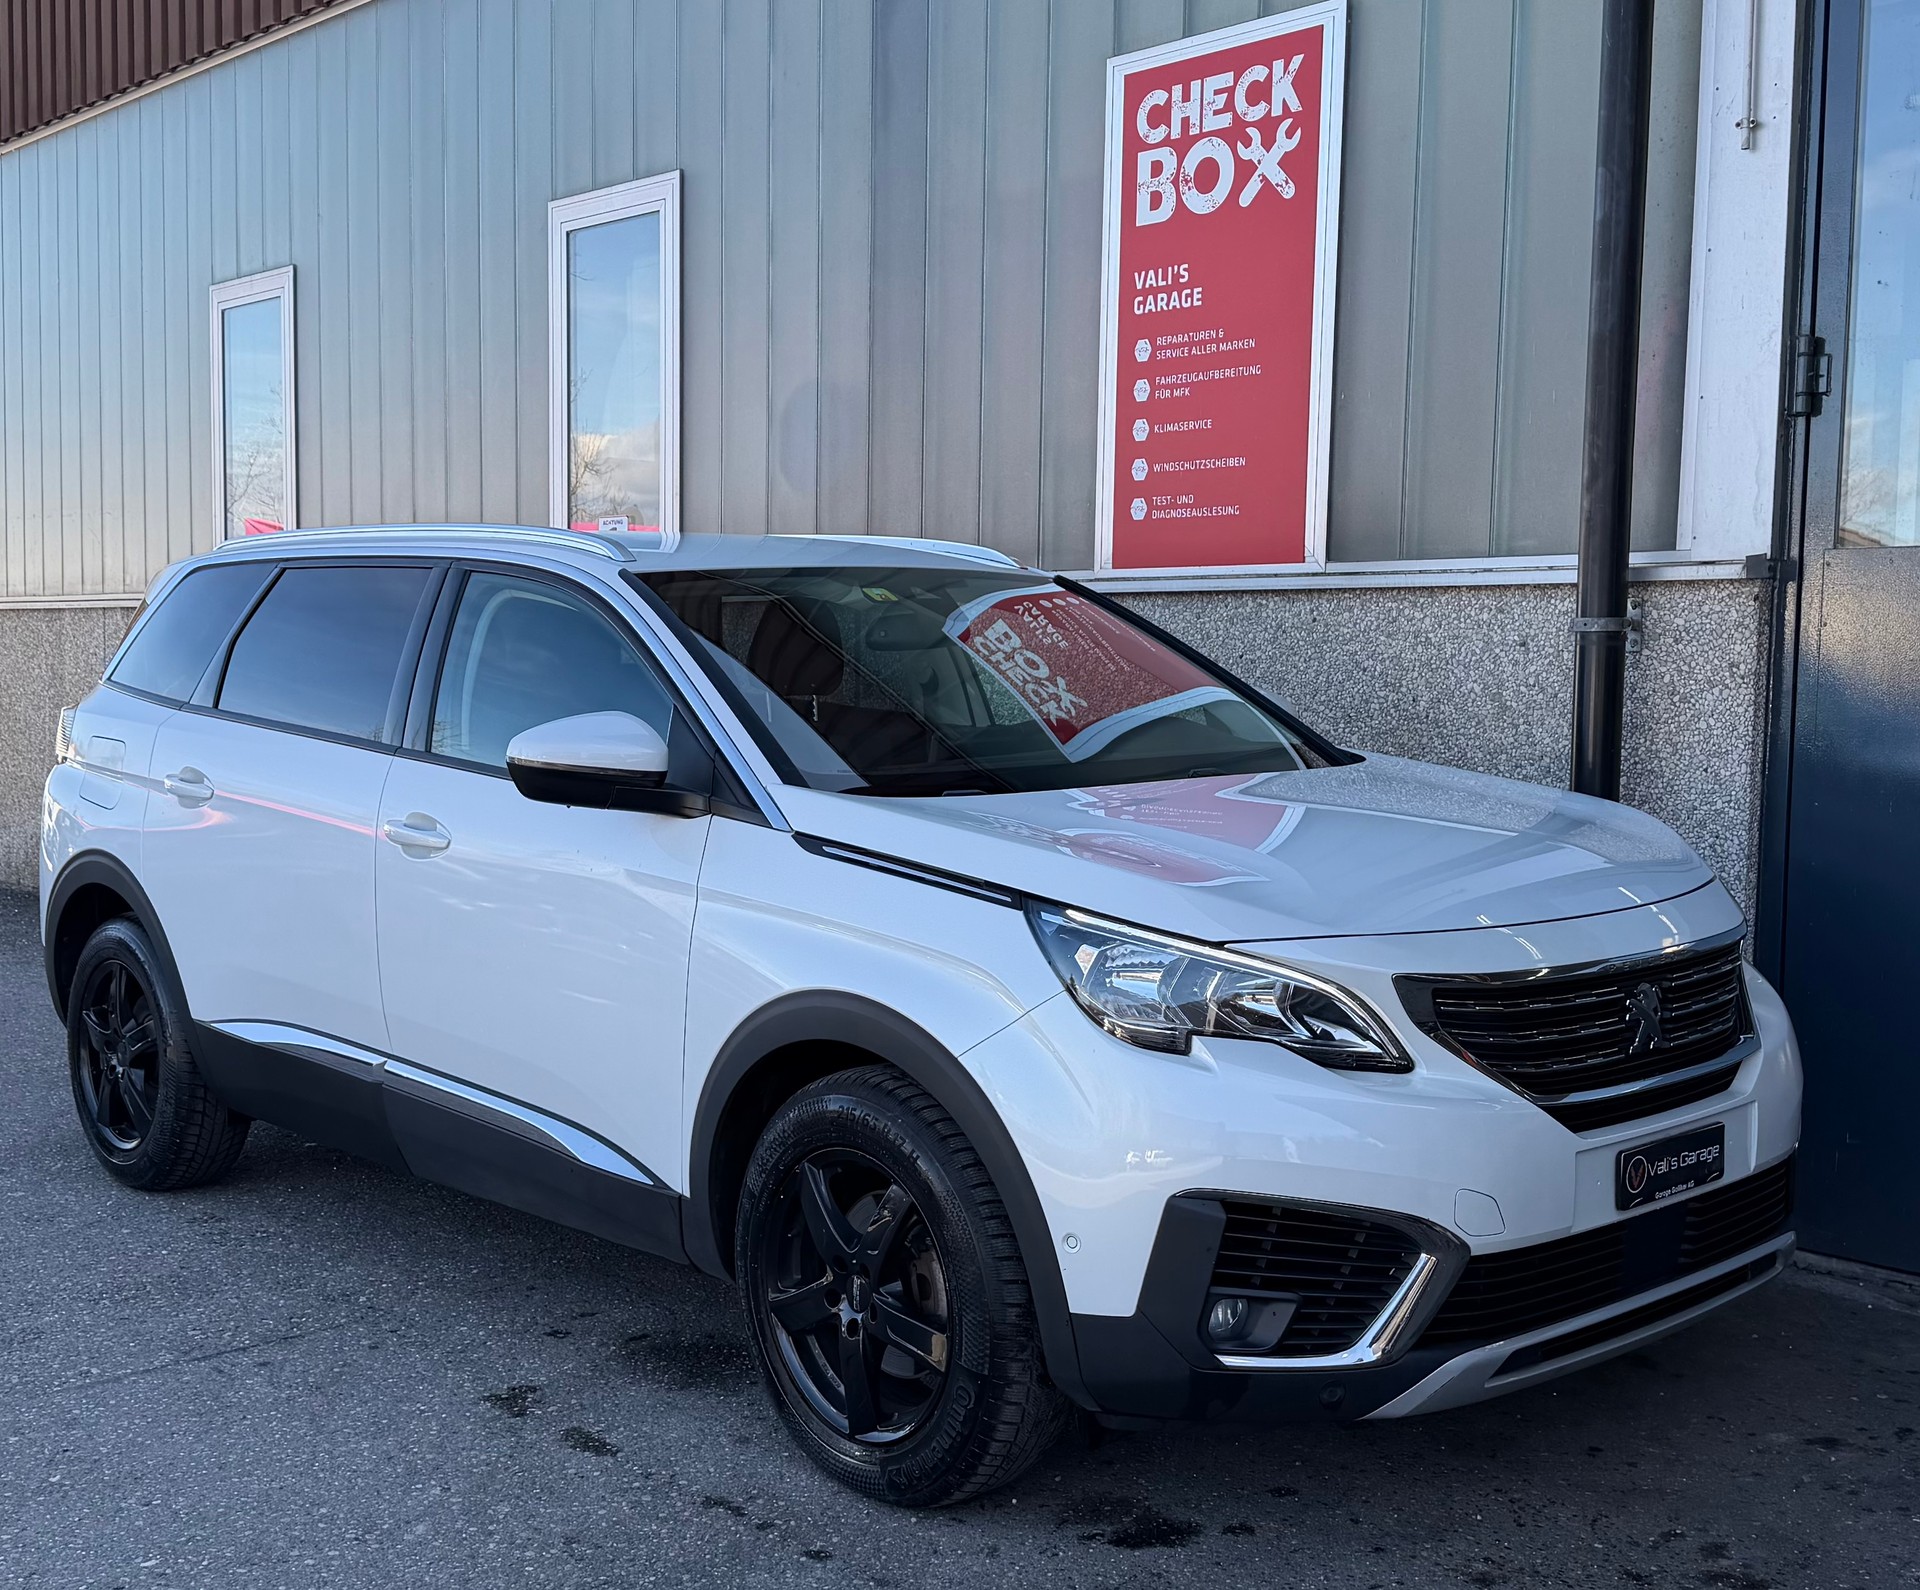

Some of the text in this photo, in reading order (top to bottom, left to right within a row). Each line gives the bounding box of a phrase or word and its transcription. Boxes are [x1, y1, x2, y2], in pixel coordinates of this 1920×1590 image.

[1136, 53, 1305, 145] CHECK
[1135, 117, 1302, 227] BOX
[1133, 263, 1190, 290] VALI'S
[1133, 286, 1203, 316] GARAGE
[1156, 328, 1225, 346] REPARATUREN &
[1156, 338, 1256, 360] SERVICE ALLER MARKEN
[1155, 364, 1262, 386] FAHRZEUGAUFBEREITUNG
[1155, 387, 1191, 400] FÜR MFK
[1154, 418, 1213, 434] KLIMASERVICE
[1153, 456, 1246, 473] WINDSCHUTZSCHEIBEN
[1152, 494, 1194, 506] TEST- UND
[1151, 505, 1240, 520] DIAGNOSEAUSLESUNG
[1648, 1145, 1720, 1176] Vali's Garage
